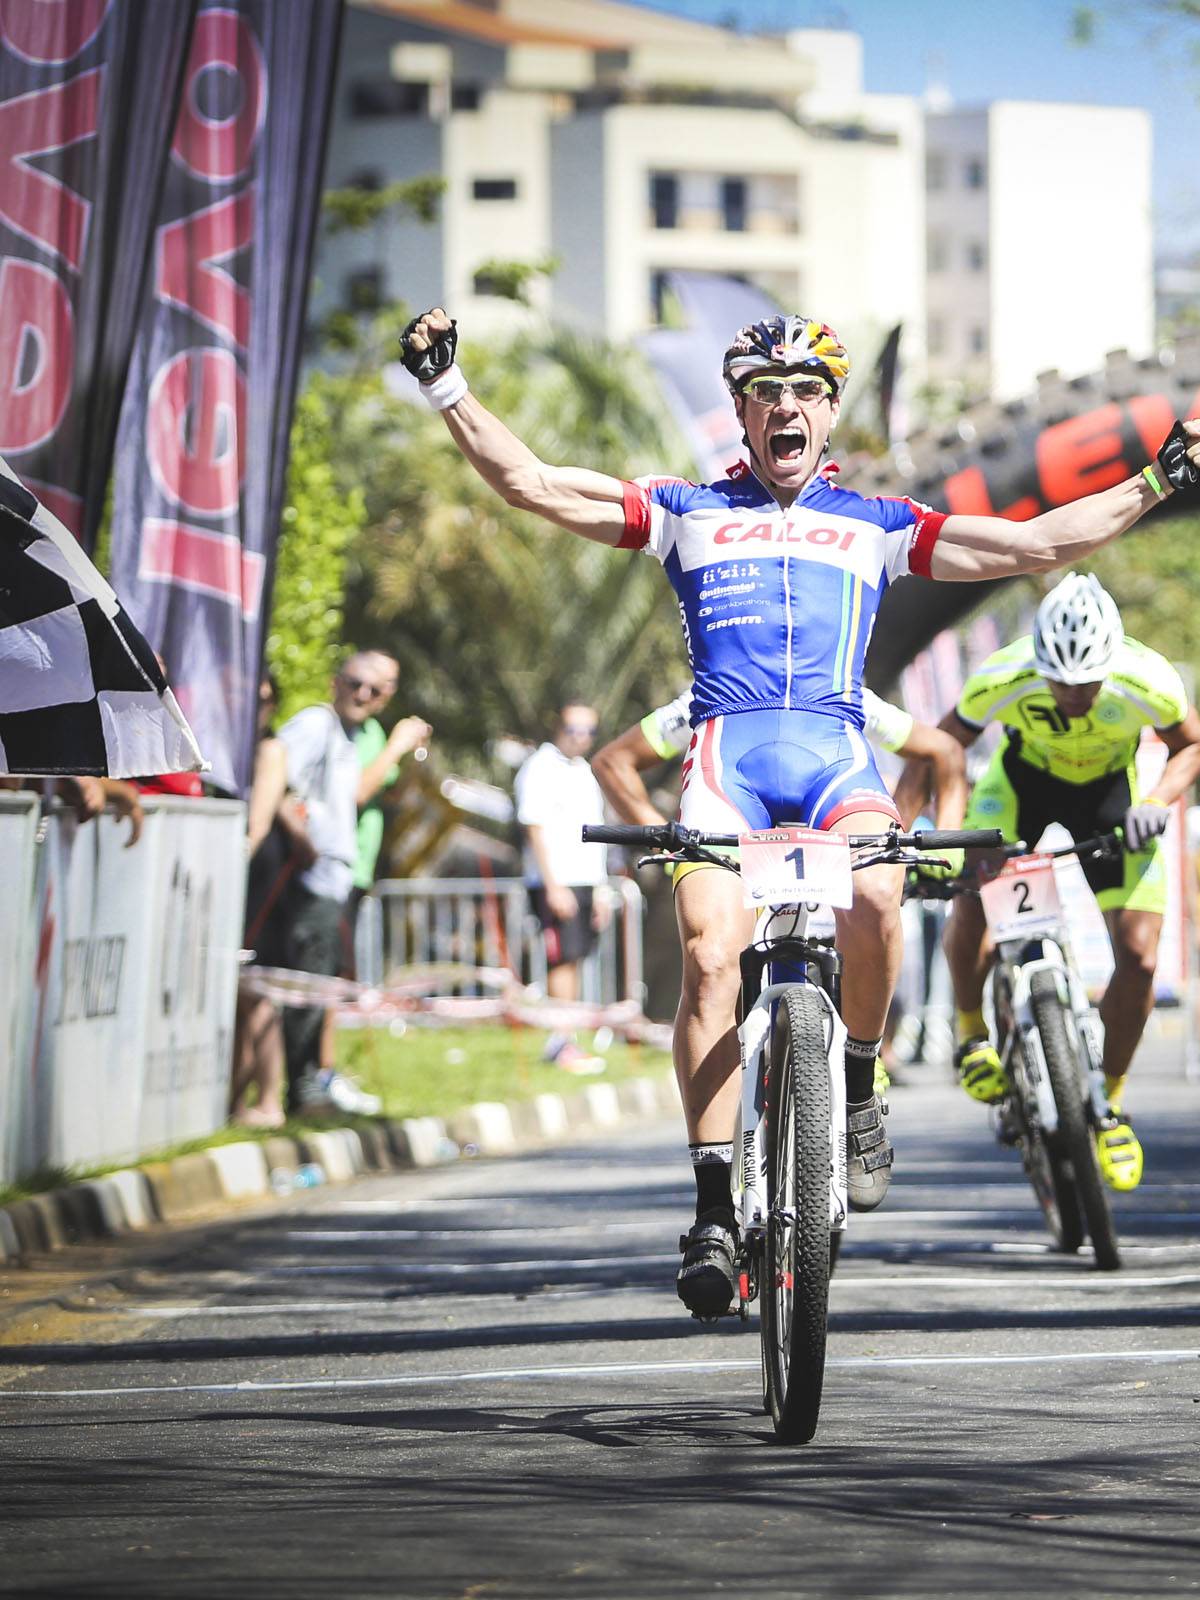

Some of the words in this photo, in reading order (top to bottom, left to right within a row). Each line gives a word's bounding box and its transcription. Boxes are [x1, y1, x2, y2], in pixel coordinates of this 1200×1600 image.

[713, 522, 857, 551] CALOI
[784, 847, 805, 880] 1
[1012, 881, 1034, 914] 2
[743, 1130, 756, 1188] ROCKSHOX
